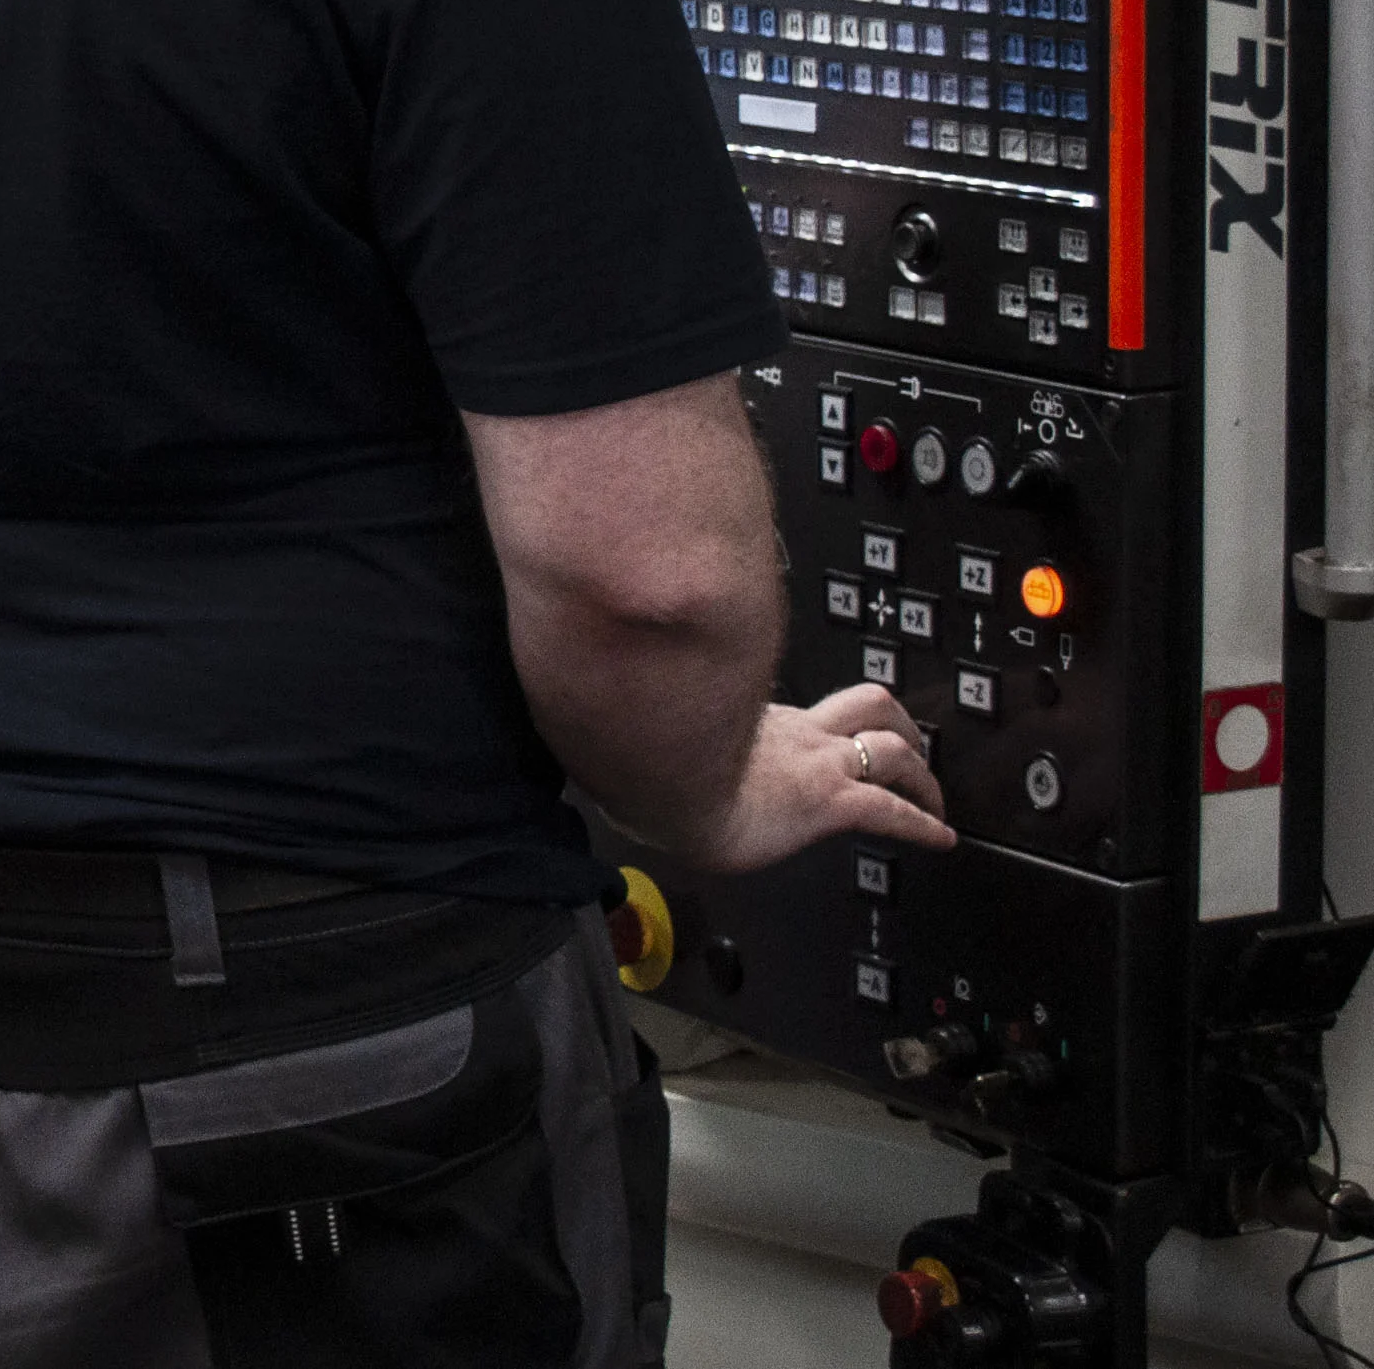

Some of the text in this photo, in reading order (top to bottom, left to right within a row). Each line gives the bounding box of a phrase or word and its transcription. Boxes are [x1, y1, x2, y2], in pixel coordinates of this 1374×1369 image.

[868, 543, 890, 564] +Y
[964, 566, 986, 588] +Z
[833, 590, 852, 611] -X
[905, 608, 926, 629] +X
[867, 657, 888, 675] -Y
